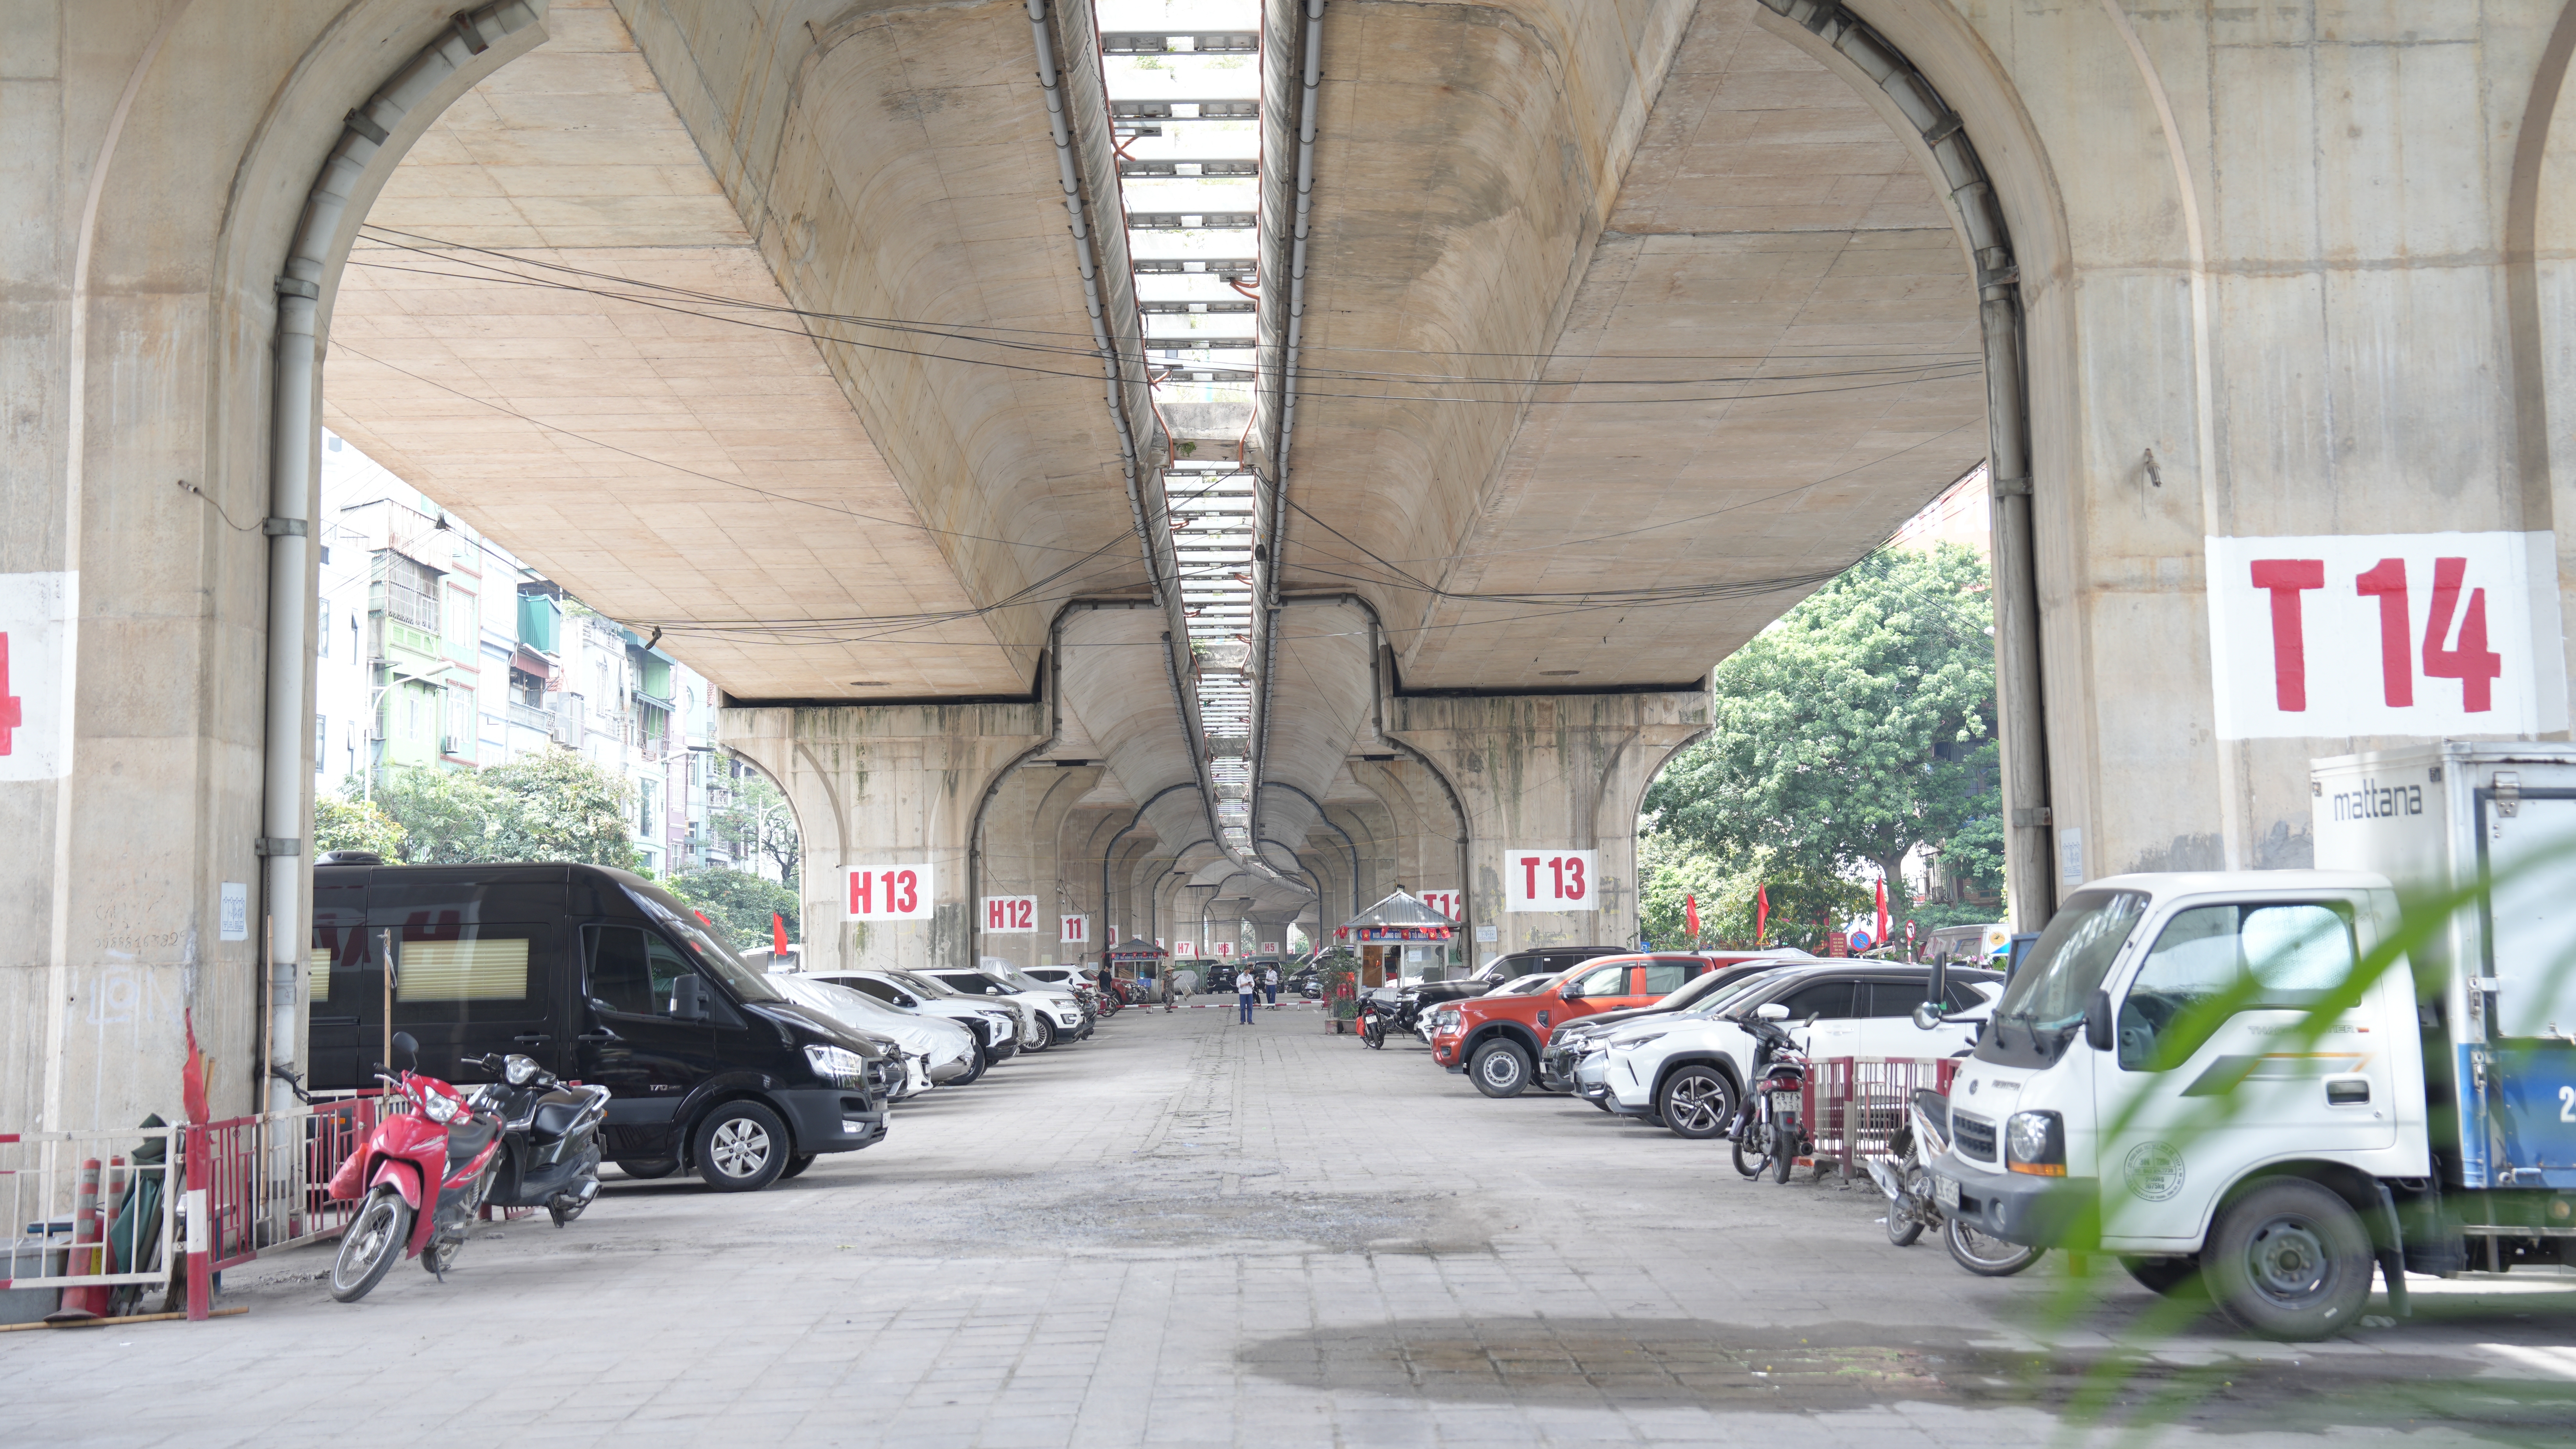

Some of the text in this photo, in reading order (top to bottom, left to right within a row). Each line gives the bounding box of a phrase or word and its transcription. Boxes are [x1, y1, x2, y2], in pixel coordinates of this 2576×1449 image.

[2250, 557, 2502, 713] T 14
[2334, 778, 2423, 821] mattana
[850, 870, 917, 914] H 13
[1521, 857, 1585, 900] T 13
[989, 899, 1032, 929] H12
[1178, 943, 1189, 954] H7
[1265, 943, 1274, 952] H5
[2558, 1086, 2576, 1123] 2
